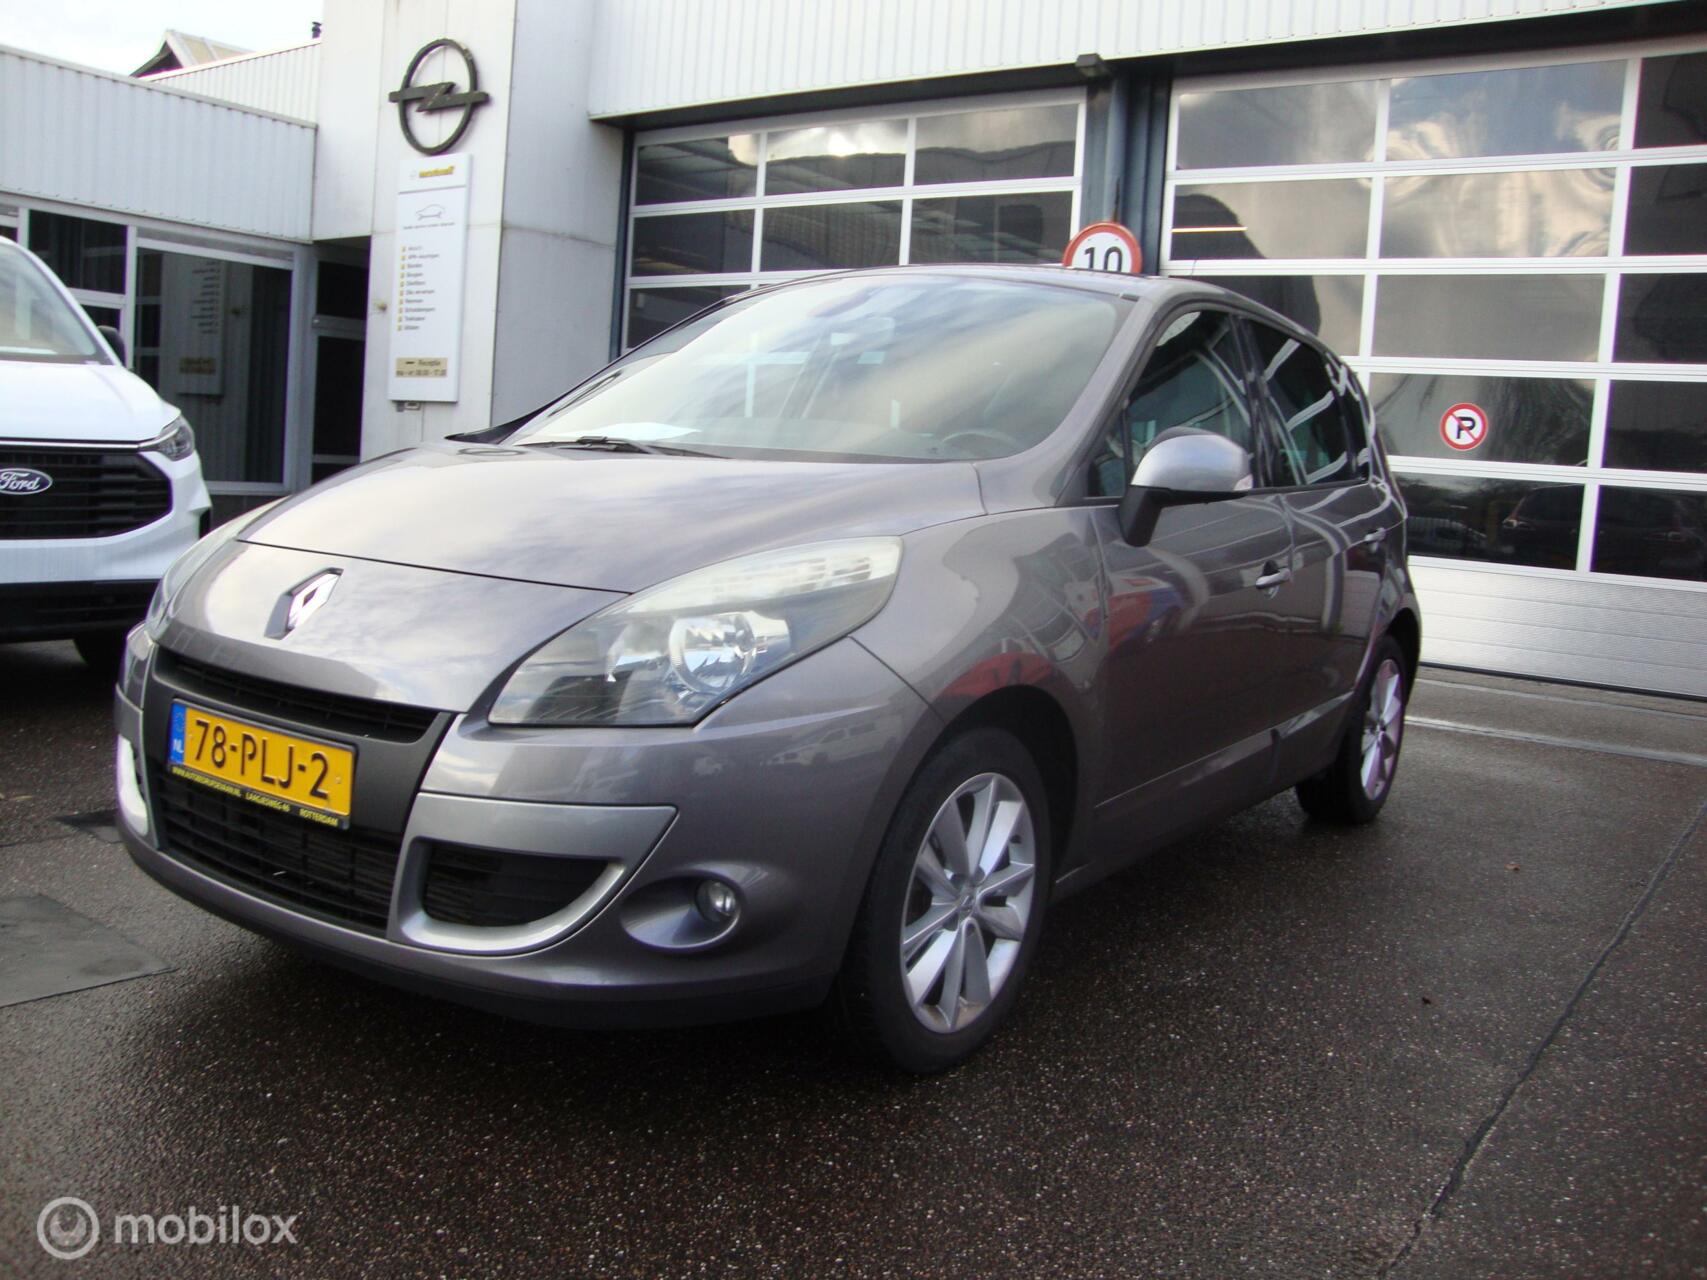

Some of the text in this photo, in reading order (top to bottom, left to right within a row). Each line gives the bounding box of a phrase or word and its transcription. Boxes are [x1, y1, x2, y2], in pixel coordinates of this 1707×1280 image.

[1084, 246, 1123, 271] 10
[0, 471, 41, 491] Ford
[172, 738, 184, 754] NL
[195, 718, 330, 801] 78-PLJ-2
